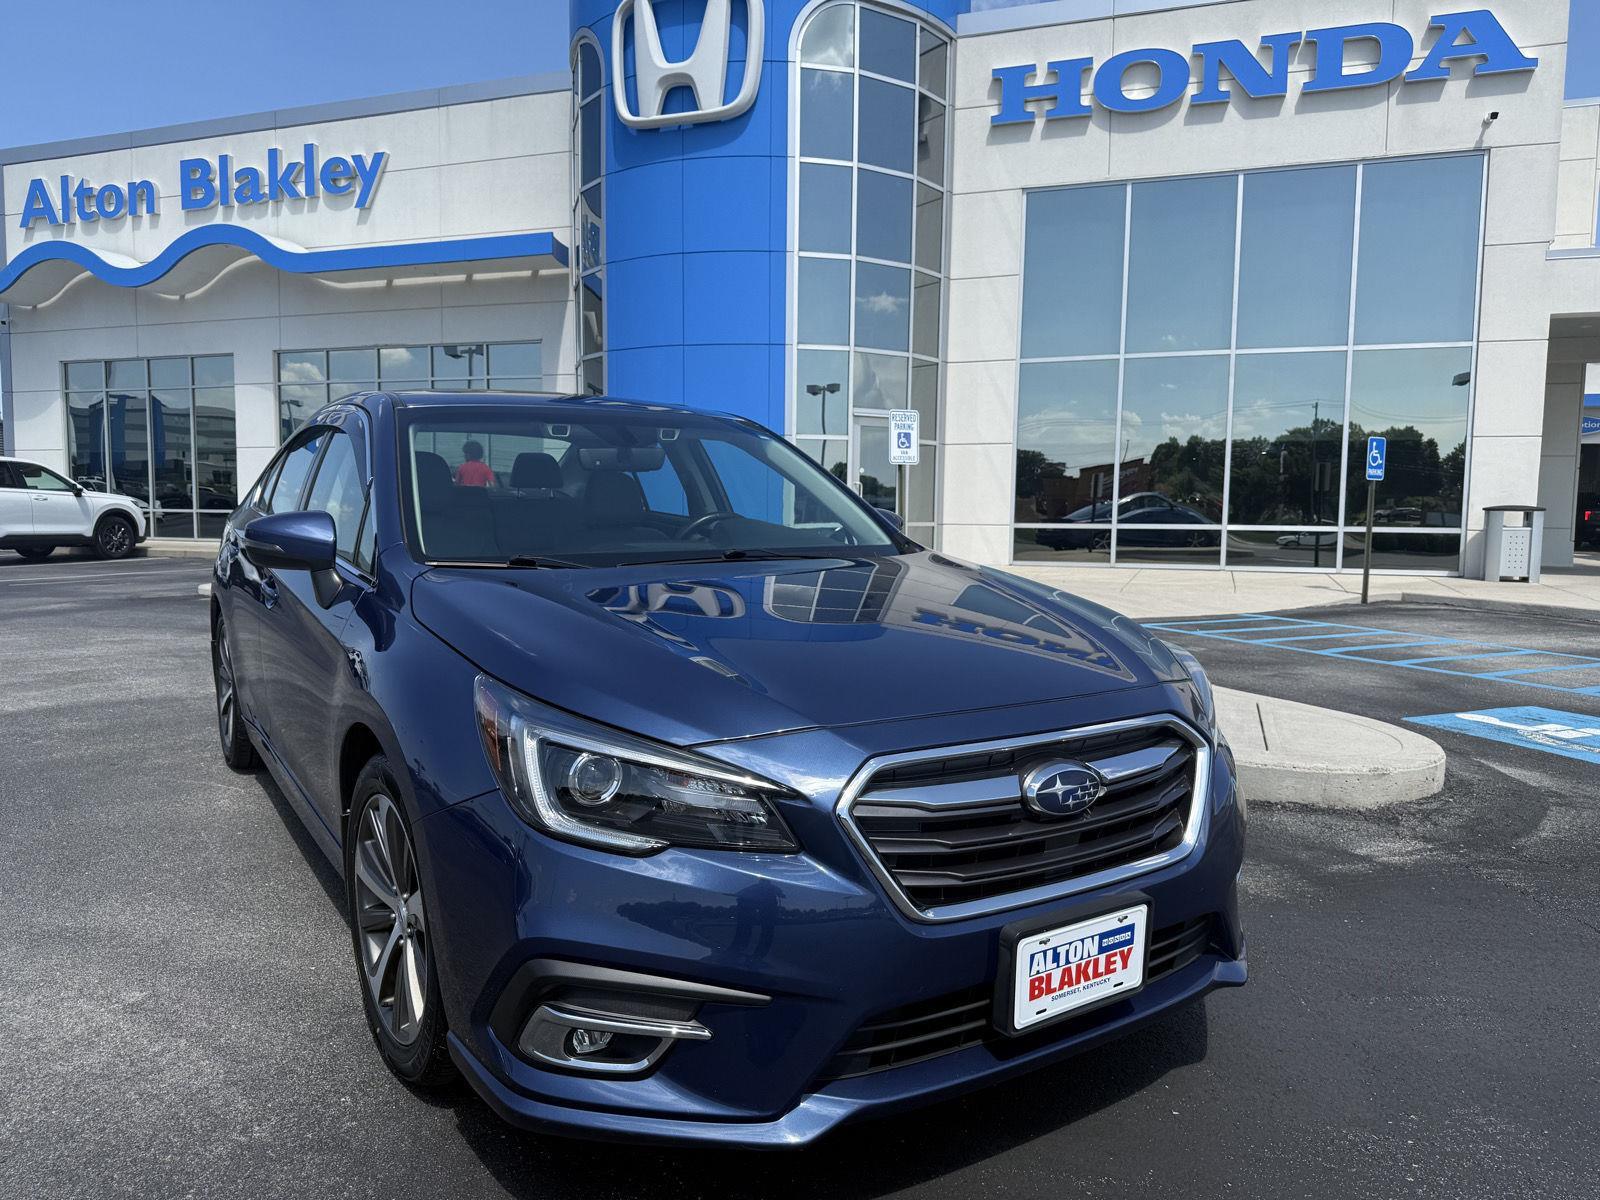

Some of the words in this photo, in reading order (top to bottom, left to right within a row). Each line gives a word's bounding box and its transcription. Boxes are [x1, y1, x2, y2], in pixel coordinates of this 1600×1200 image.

[991, 9, 1538, 126] HONDA
[20, 174, 158, 229] Alton
[180, 143, 389, 211] Blakley
[892, 413, 916, 422] RESERVED
[894, 423, 914, 431] PARKING
[1368, 467, 1383, 476] PARKING
[1102, 931, 1131, 947] HONDA
[1030, 935, 1100, 976] ALTON
[1029, 947, 1134, 1002] BLAKLEY
[1051, 987, 1082, 1002] SOMERSET,
[1083, 977, 1111, 991] KENTUCKY
